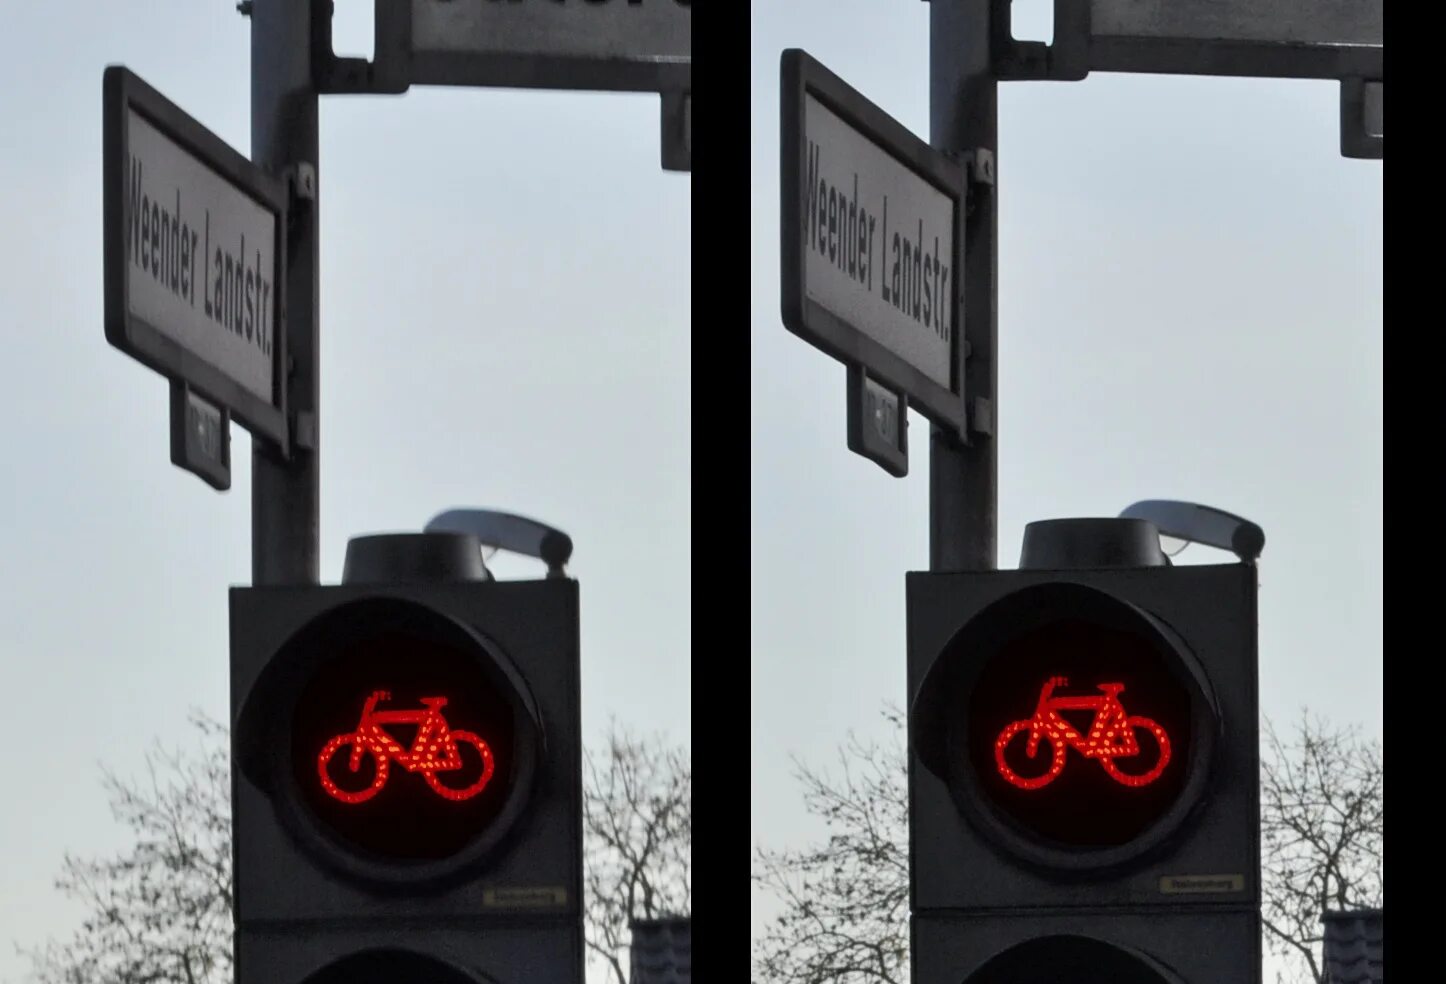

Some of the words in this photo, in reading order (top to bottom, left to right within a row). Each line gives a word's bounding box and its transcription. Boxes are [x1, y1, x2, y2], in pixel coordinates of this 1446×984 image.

[129, 153, 198, 307] Weender
[204, 209, 271, 357] Landstr.
[805, 136, 876, 292] Weender
[882, 195, 949, 343] Landstr.
